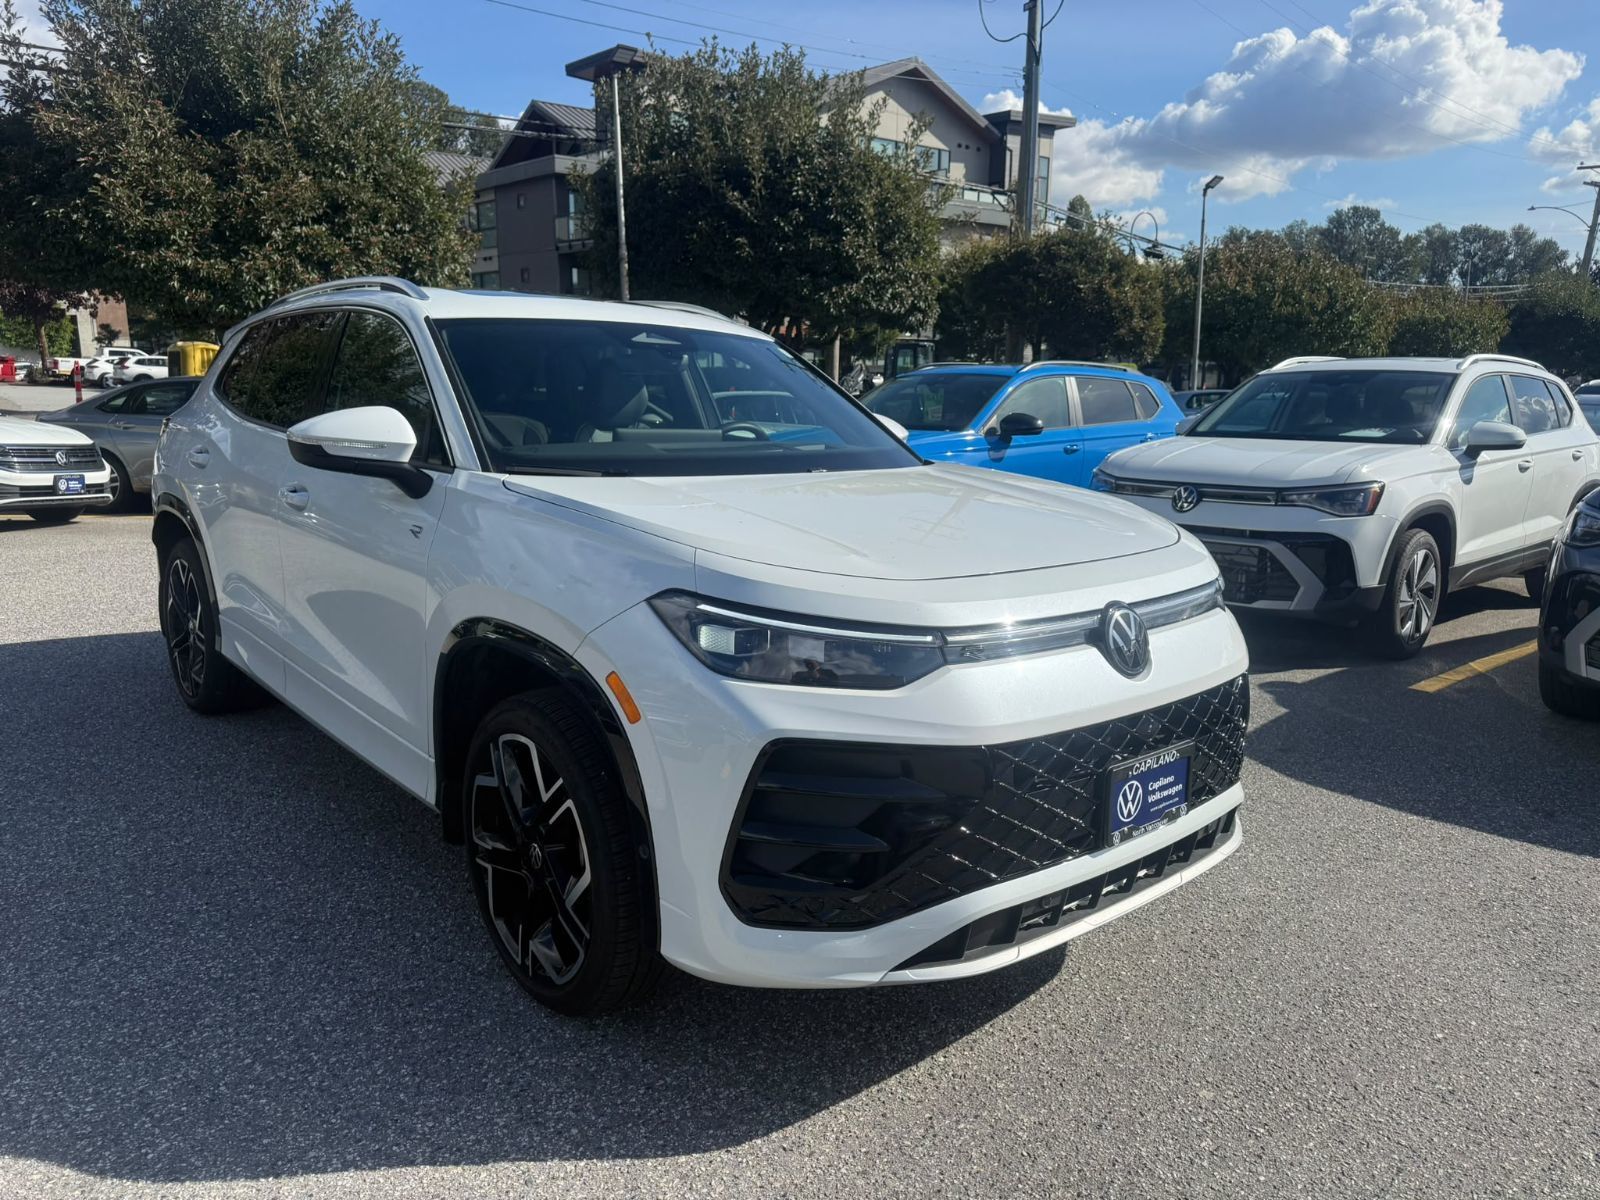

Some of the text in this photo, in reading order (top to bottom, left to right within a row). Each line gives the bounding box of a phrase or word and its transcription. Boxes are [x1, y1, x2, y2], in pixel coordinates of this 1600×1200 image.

[1133, 751, 1177, 775] CAPILANO
[1149, 776, 1174, 791] Capilano
[1148, 784, 1182, 803] Volkswagen
